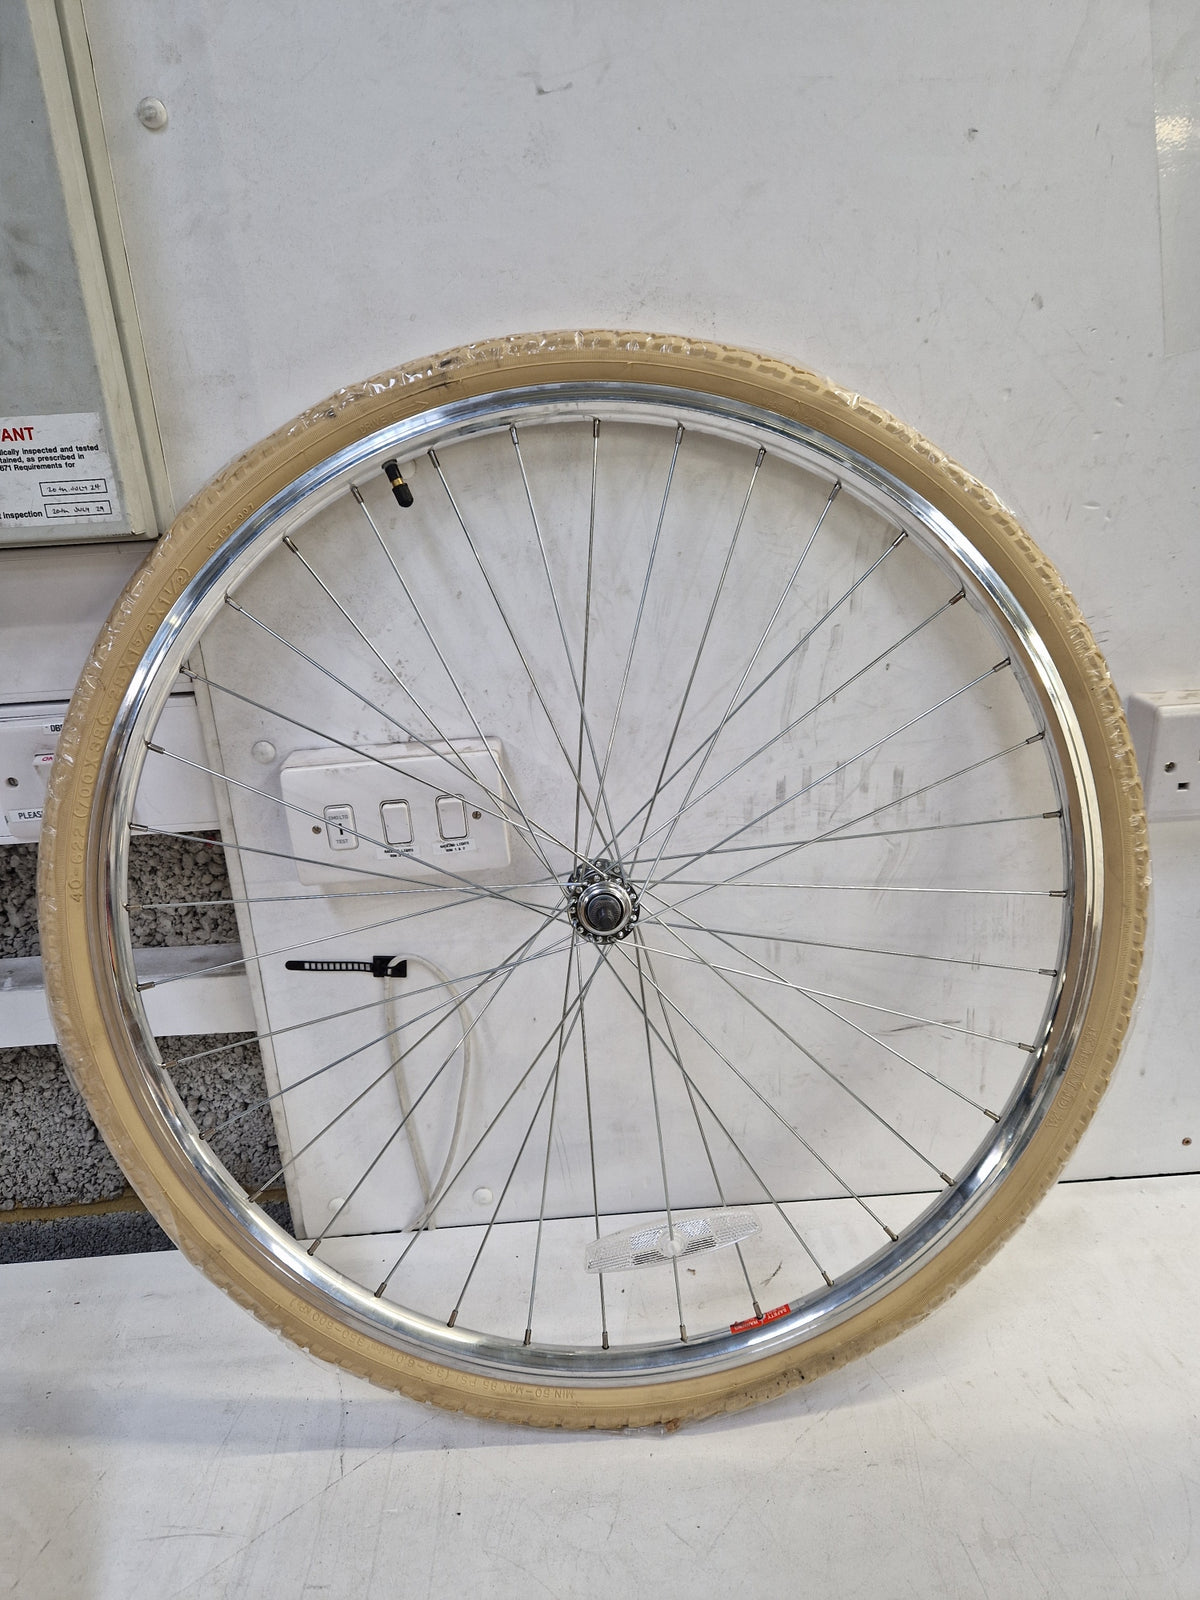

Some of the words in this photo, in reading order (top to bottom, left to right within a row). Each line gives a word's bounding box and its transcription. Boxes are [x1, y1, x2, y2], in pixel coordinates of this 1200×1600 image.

[360, 413, 388, 434] DRIVE
[22, 446, 57, 455] inspected
[60, 445, 73, 453] and
[76, 444, 99, 452] tested
[38, 454, 75, 462] prescribed
[14, 462, 62, 471] Requirements
[3, 511, 43, 520] inspection
[18, 810, 43, 819] PLEAS
[554, 1388, 574, 1399] MIN
